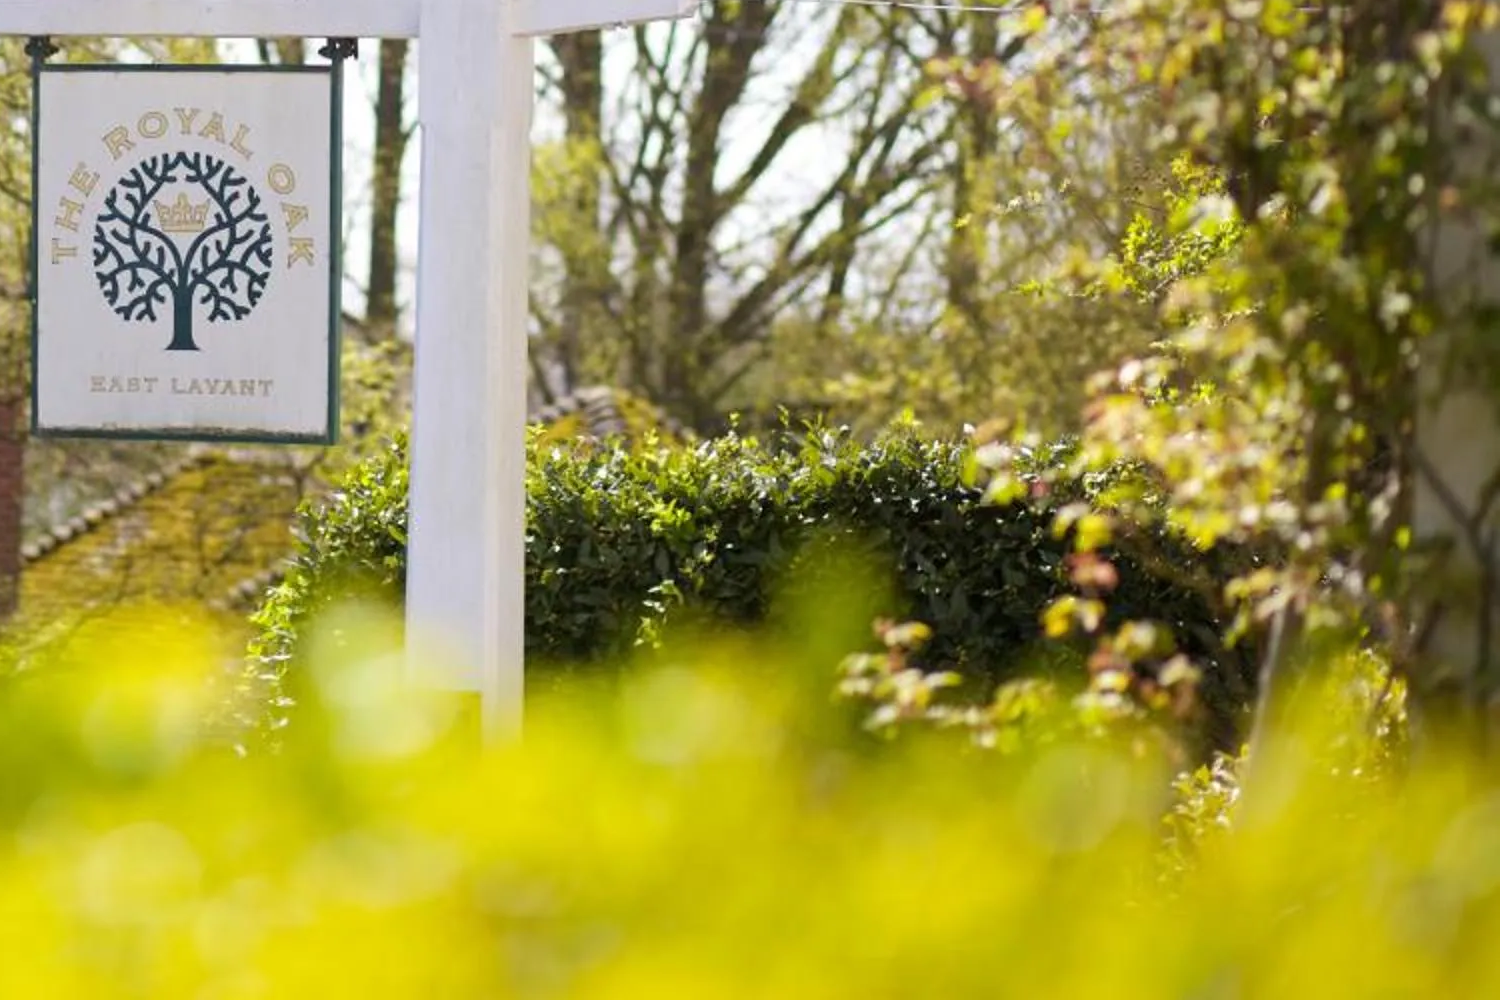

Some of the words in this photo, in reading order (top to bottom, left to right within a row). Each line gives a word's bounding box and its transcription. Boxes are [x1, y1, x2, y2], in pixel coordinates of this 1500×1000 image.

[51, 161, 99, 265] THE
[102, 107, 255, 161] ROYAL
[267, 162, 317, 268] OAK
[89, 375, 159, 395] EAST
[170, 376, 275, 398] LAVANT
